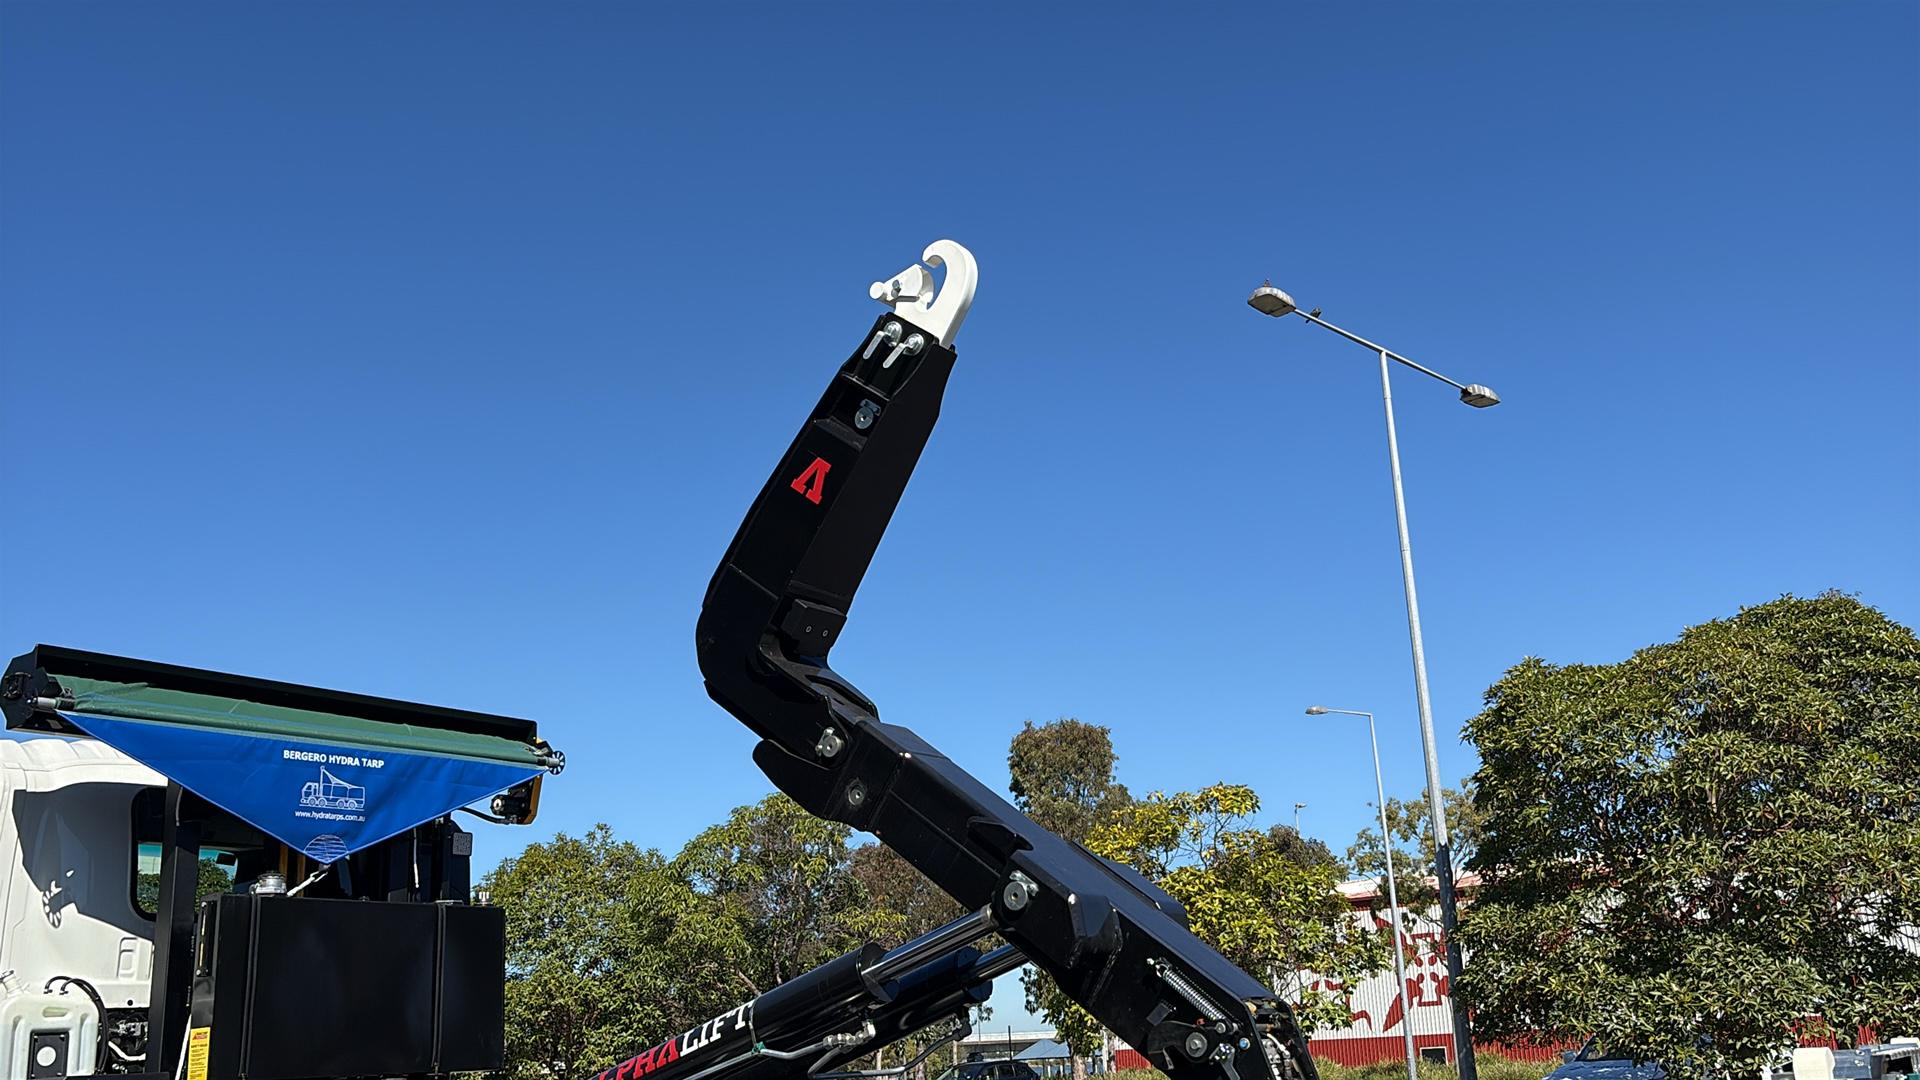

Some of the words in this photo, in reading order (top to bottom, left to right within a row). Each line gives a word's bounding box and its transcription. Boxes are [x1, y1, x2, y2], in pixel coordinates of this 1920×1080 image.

[283, 749, 327, 763] BERGERO
[328, 754, 361, 767] HYDRA
[361, 758, 385, 769] TARP
[294, 810, 366, 822] www.hydratarps.com.au
